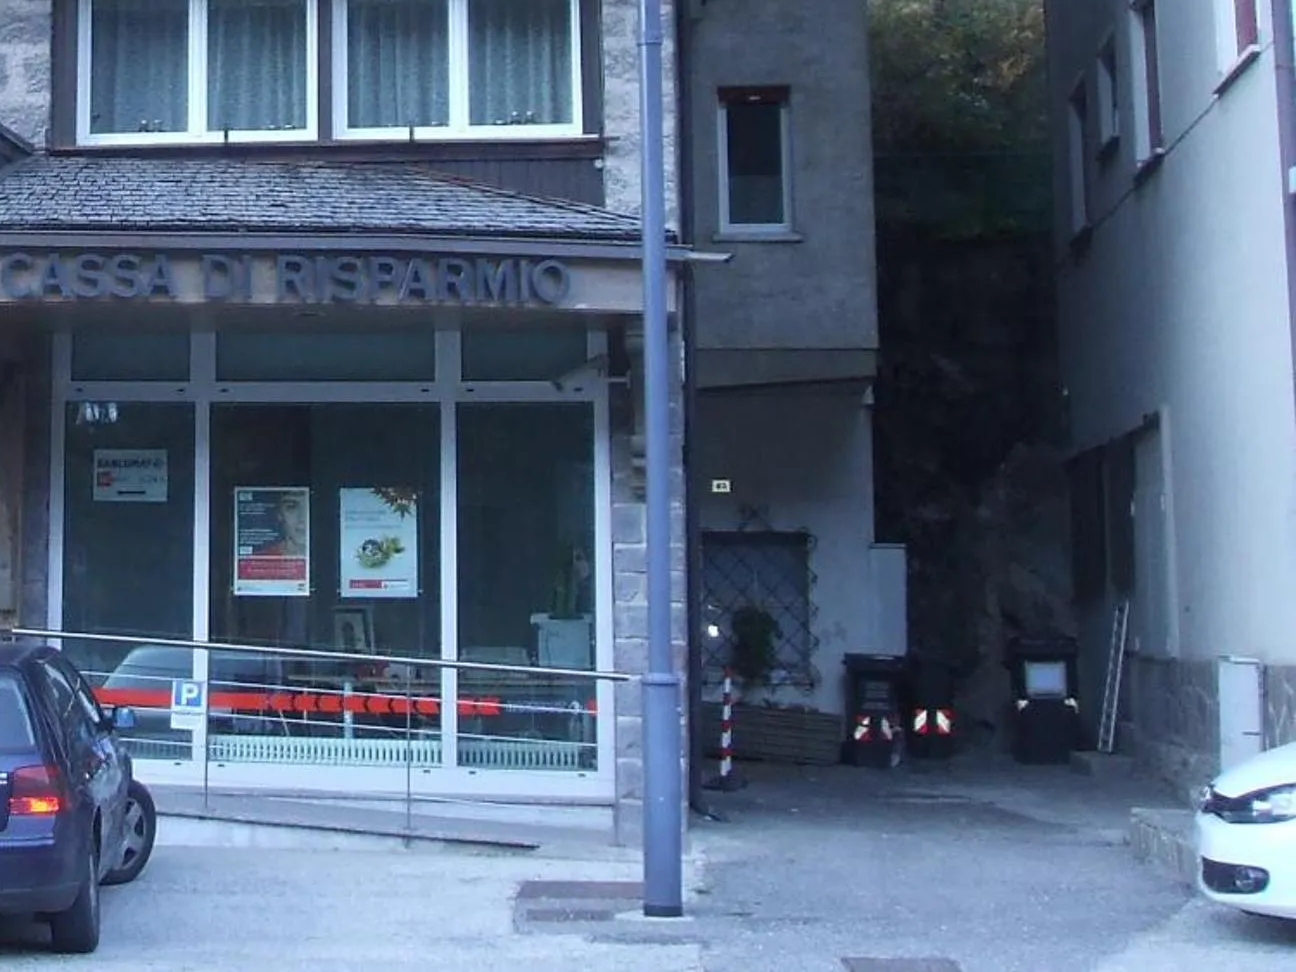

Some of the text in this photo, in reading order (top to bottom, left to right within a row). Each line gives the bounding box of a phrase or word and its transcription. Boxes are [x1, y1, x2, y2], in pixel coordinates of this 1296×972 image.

[3, 253, 571, 304] CASSA DI RISPARMIO
[181, 683, 199, 705] P
